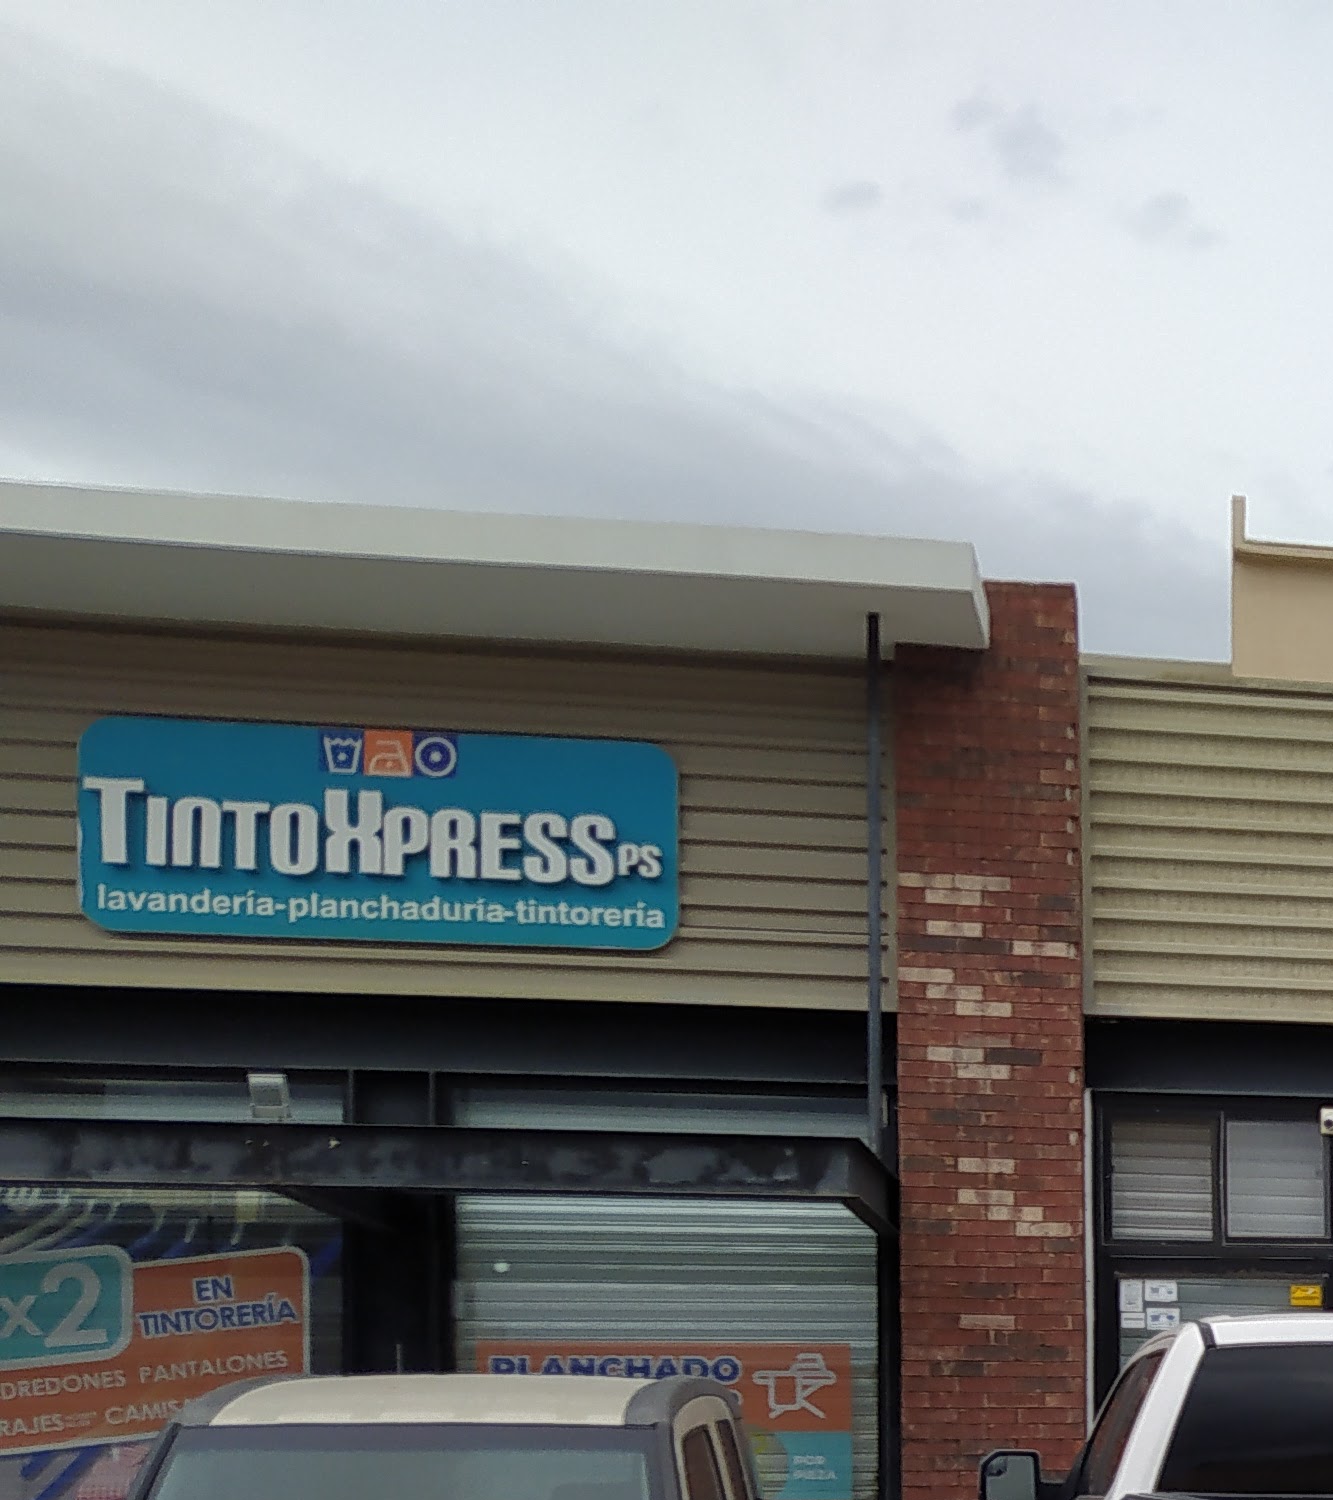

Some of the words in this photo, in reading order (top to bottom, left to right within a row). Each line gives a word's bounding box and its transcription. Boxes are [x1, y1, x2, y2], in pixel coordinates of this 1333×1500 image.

[195, 1276, 233, 1302] EN
[139, 1293, 297, 1336] TINTORERÍA
[139, 1351, 288, 1384] PANTALONES
